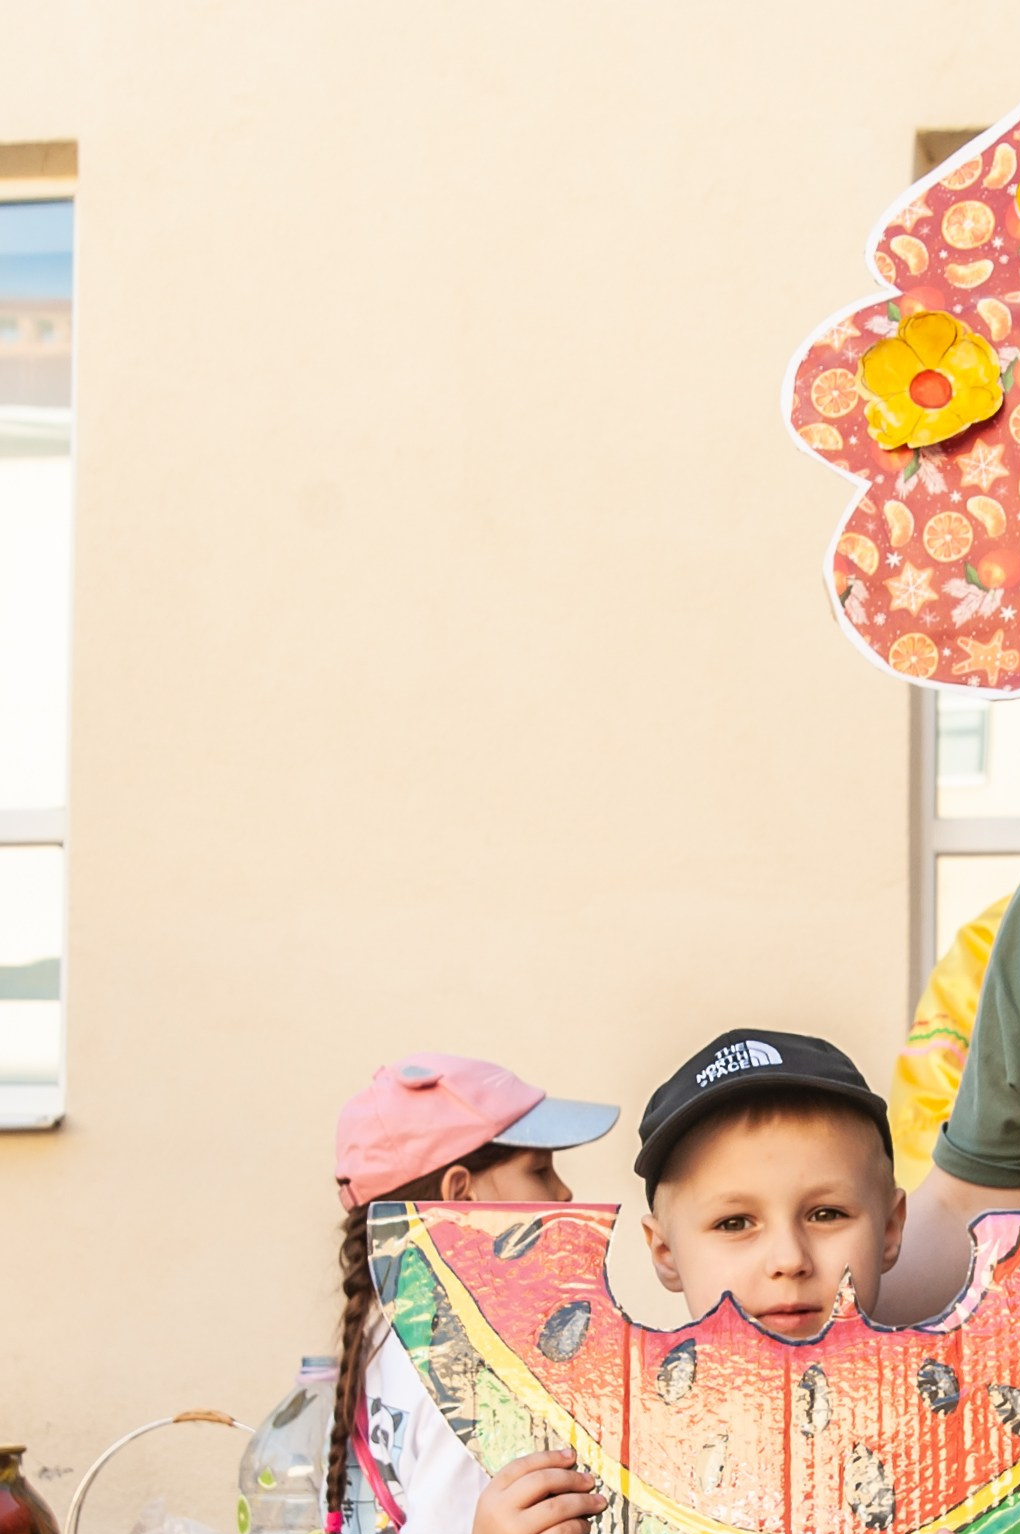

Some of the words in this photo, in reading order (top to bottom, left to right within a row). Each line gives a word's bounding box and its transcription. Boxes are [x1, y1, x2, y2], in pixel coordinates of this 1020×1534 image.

[714, 1042, 746, 1060] THE
[695, 1050, 750, 1084] NORTH
[708, 1059, 751, 1083] FACE
